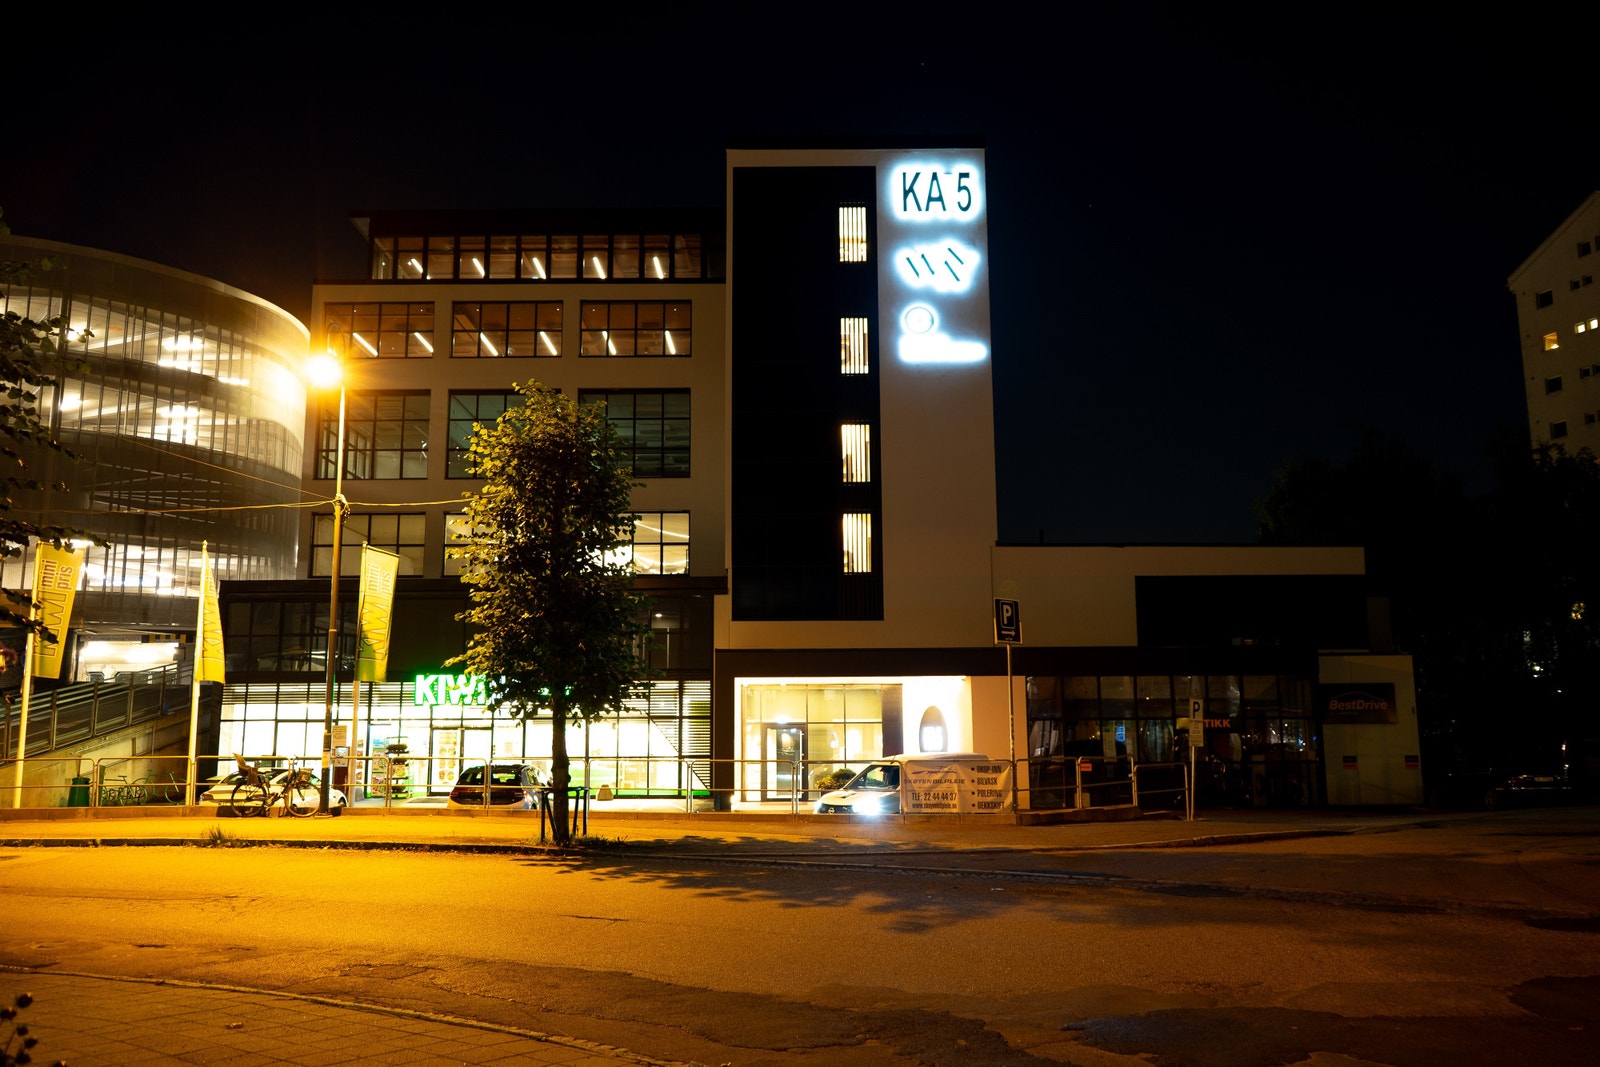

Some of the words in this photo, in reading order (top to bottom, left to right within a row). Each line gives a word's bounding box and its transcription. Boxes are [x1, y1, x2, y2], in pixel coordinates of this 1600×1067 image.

[902, 172, 947, 212] KA
[957, 172, 972, 212] 5
[40, 559, 58, 588] mini
[56, 566, 73, 591] pris
[366, 562, 381, 591] mini
[1003, 604, 1012, 625] P
[357, 594, 391, 661] KIWI
[1193, 701, 1201, 718] P
[1329, 699, 1388, 711] BestDrive
[923, 792, 931, 801] 22
[932, 792, 940, 801] 44
[941, 792, 949, 801] 44
[949, 792, 957, 801] 37
